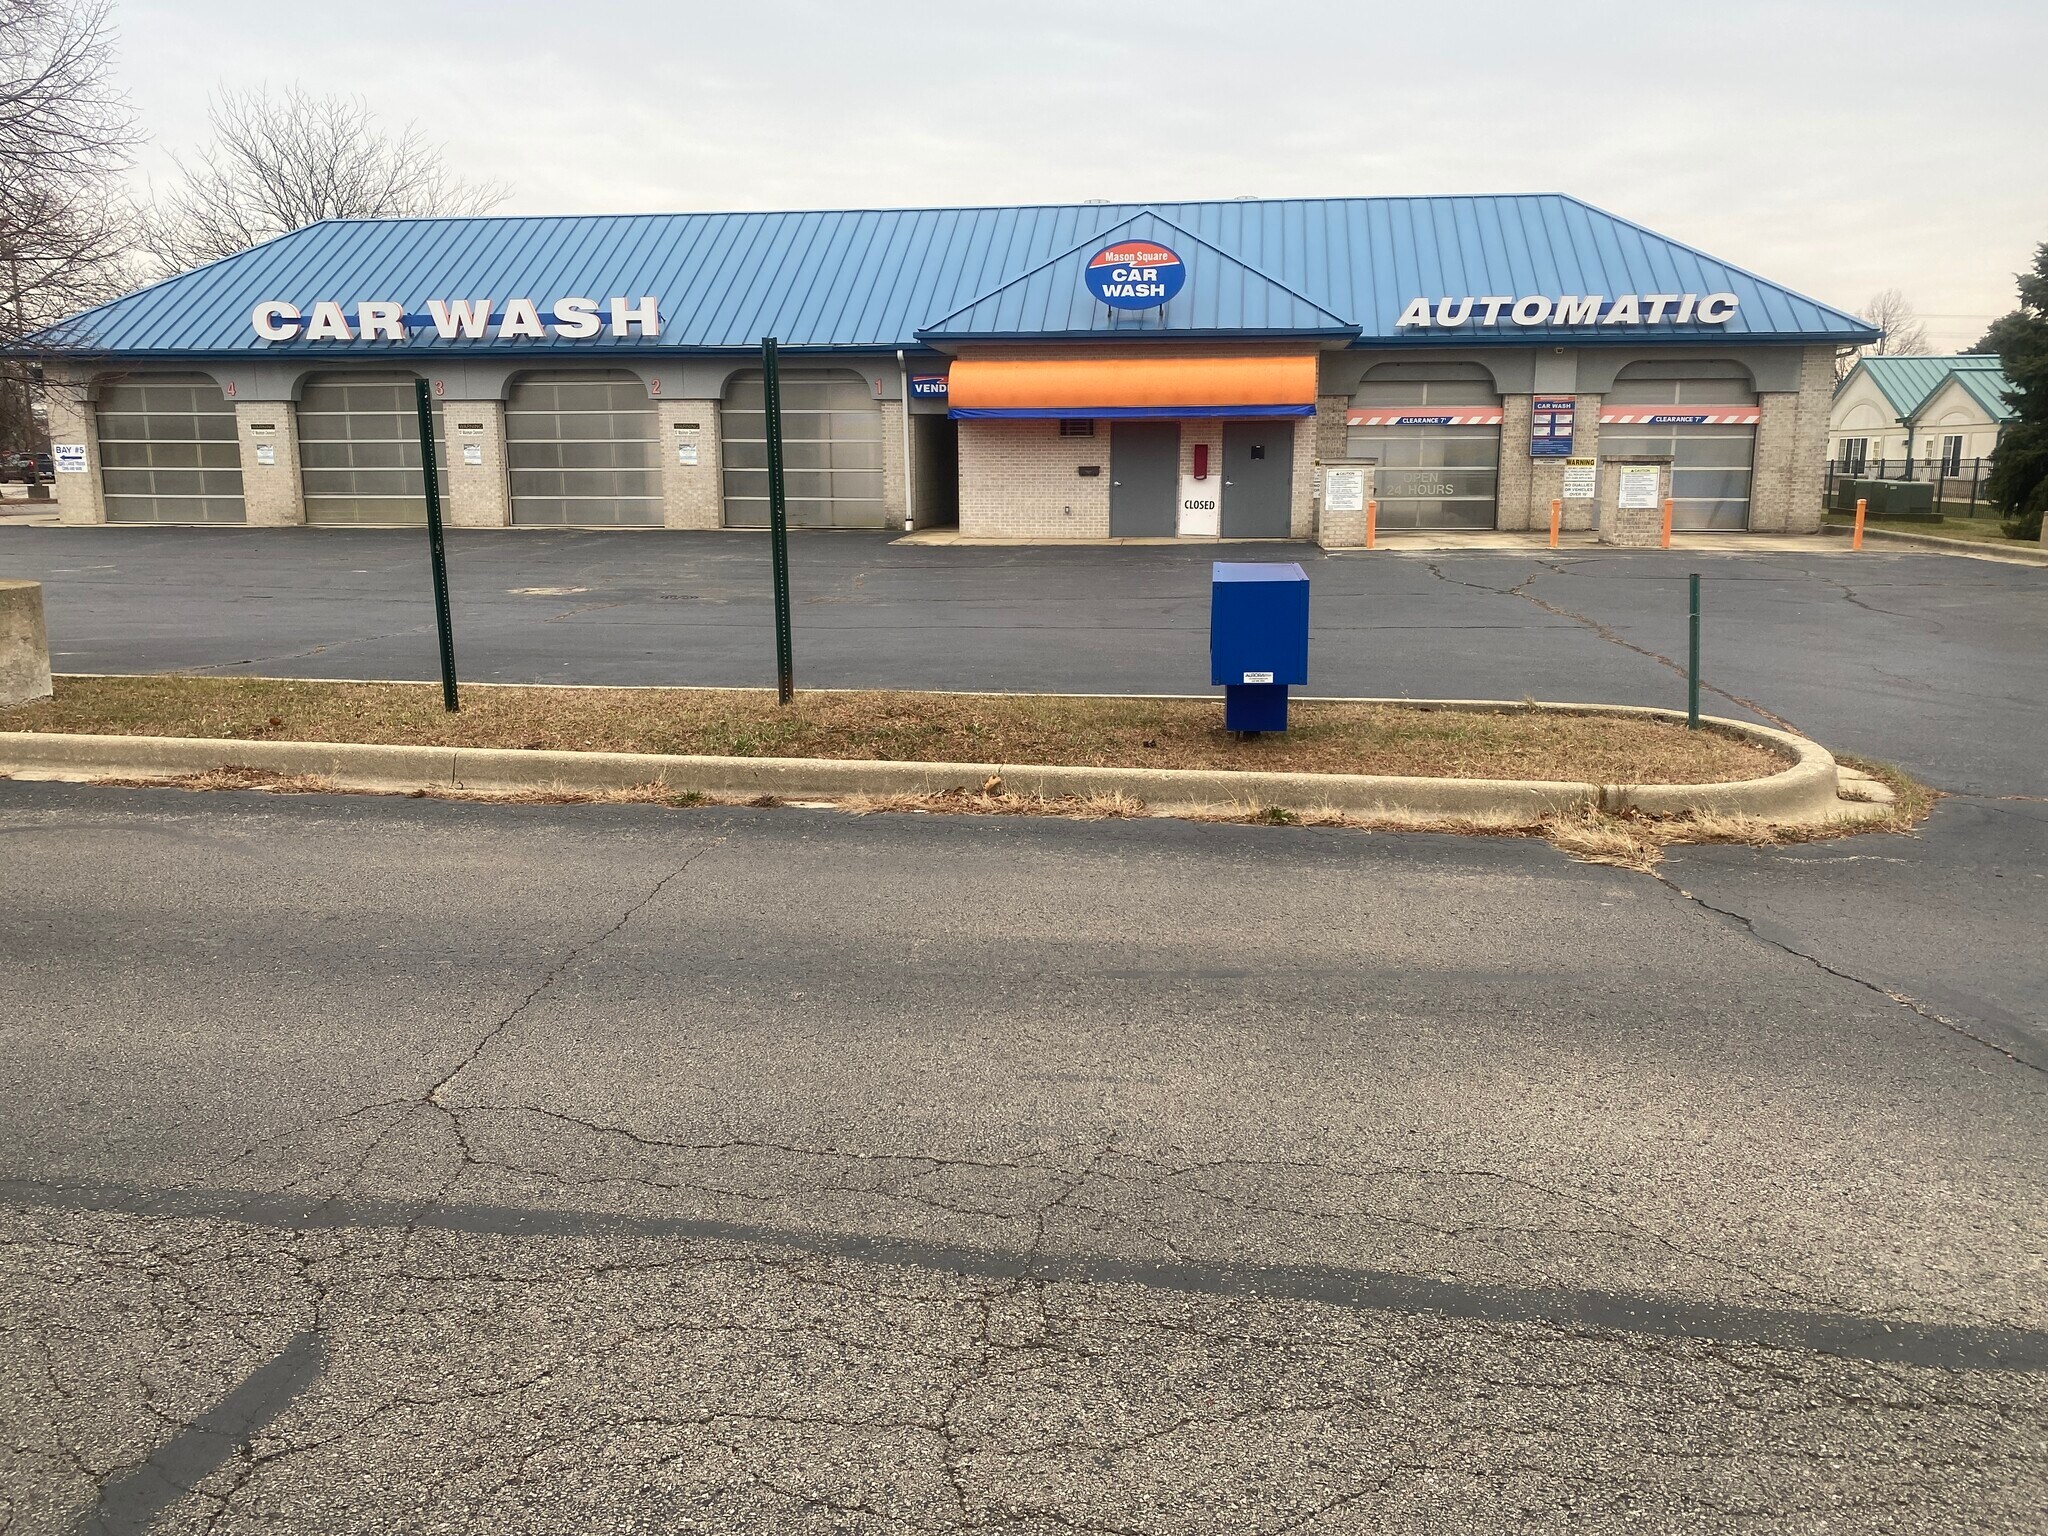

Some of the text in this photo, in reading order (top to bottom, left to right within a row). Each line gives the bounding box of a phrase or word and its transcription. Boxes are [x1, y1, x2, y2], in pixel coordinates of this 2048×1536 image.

[1105, 251, 1168, 262] Mason Square
[1112, 268, 1157, 282] CAR
[1102, 283, 1165, 297] WASH
[1395, 292, 1739, 327] AUTOMATIC
[252, 296, 659, 341] CAR WASH
[227, 381, 236, 396] 4
[435, 380, 444, 396] 3
[651, 379, 661, 395] 2
[875, 378, 882, 395] 1
[1403, 472, 1439, 483] OPEN
[1387, 484, 1454, 496] 24 HOURS
[1184, 500, 1215, 510] CLOSED
